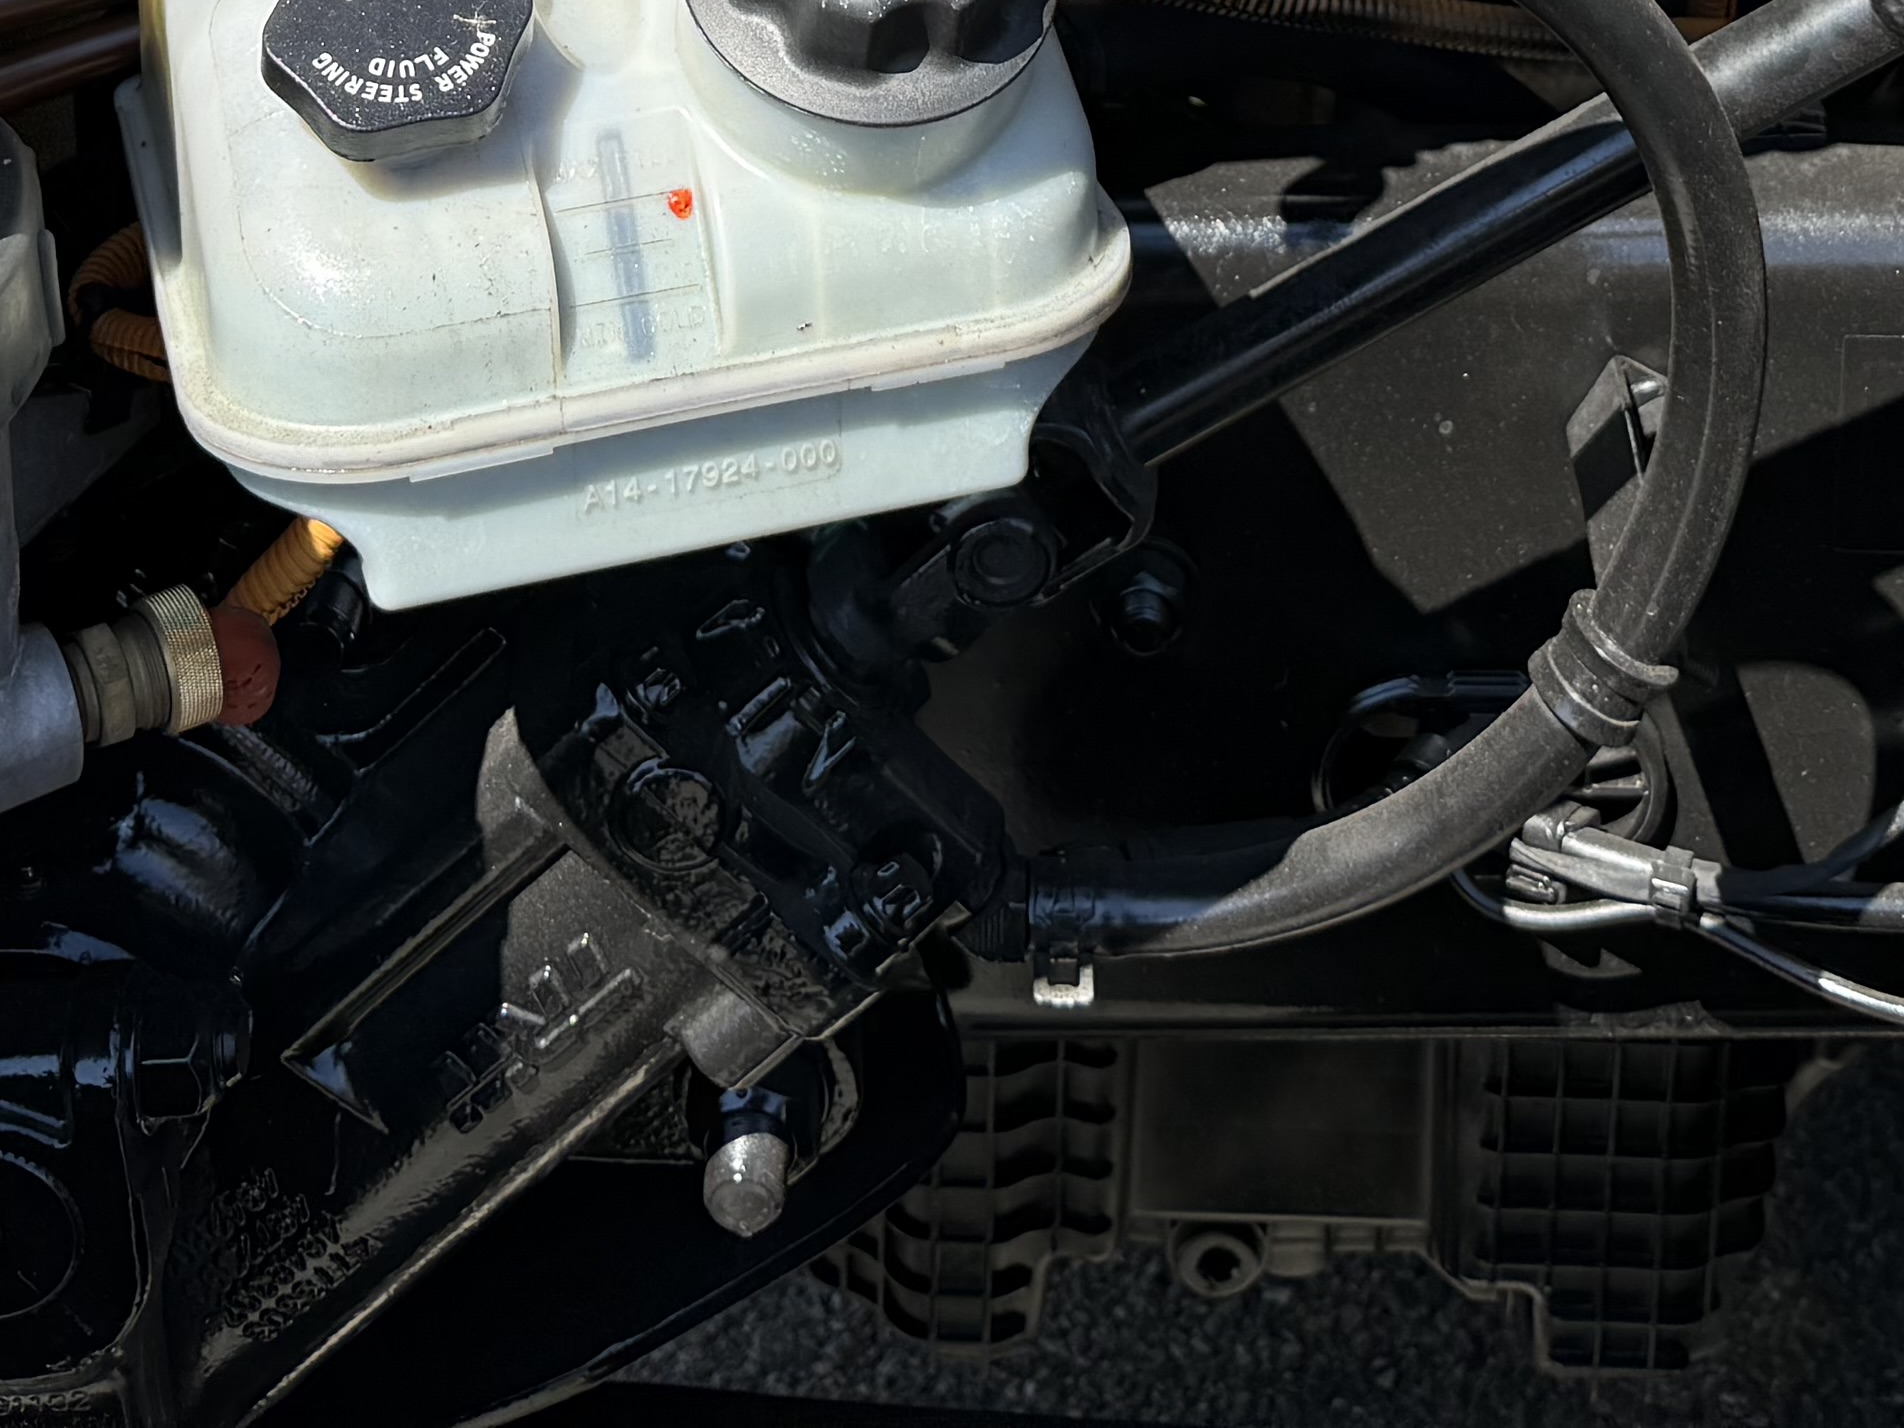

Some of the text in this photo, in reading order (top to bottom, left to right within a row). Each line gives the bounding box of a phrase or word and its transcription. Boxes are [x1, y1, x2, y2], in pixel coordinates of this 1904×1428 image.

[312, 30, 496, 104] POWER STEERING
[368, 46, 450, 79] FLUID
[583, 439, 841, 514] A14-17924-000
